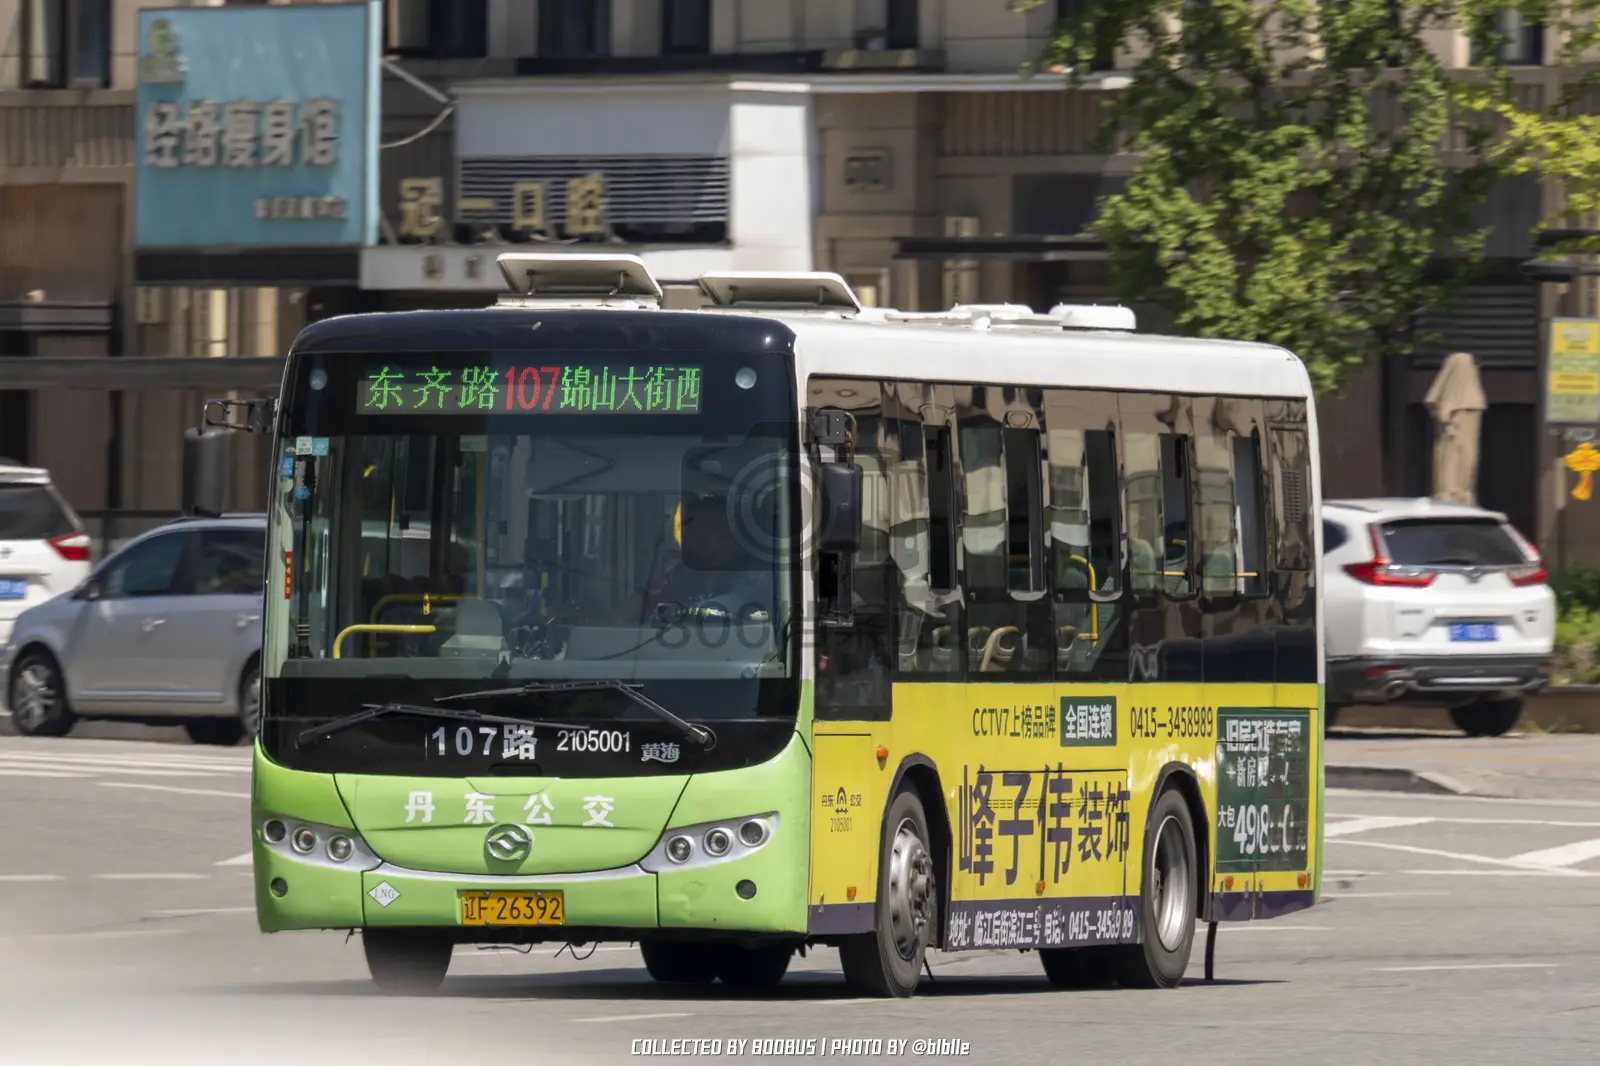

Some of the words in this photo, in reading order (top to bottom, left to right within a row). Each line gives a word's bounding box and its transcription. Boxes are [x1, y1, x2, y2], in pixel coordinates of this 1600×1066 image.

[364, 365, 500, 412] 东齐路
[504, 365, 561, 411] 107
[559, 365, 701, 412] 锦山大街西
[972, 703, 1056, 739] CCTV7上榜品牌
[1064, 703, 1113, 740] 全国连锁
[1129, 705, 1214, 738] 0415-3458989
[431, 724, 538, 761] 107路
[556, 728, 631, 753] 2105001
[640, 742, 681, 763] 黄海
[403, 789, 616, 828] 丹东公交
[821, 794, 835, 808] 丹东
[849, 793, 863, 807] 公交
[1217, 804, 1236, 829] 大包
[958, 761, 1131, 887] 峰子伟装饰
[374, 887, 396, 900] LNG
